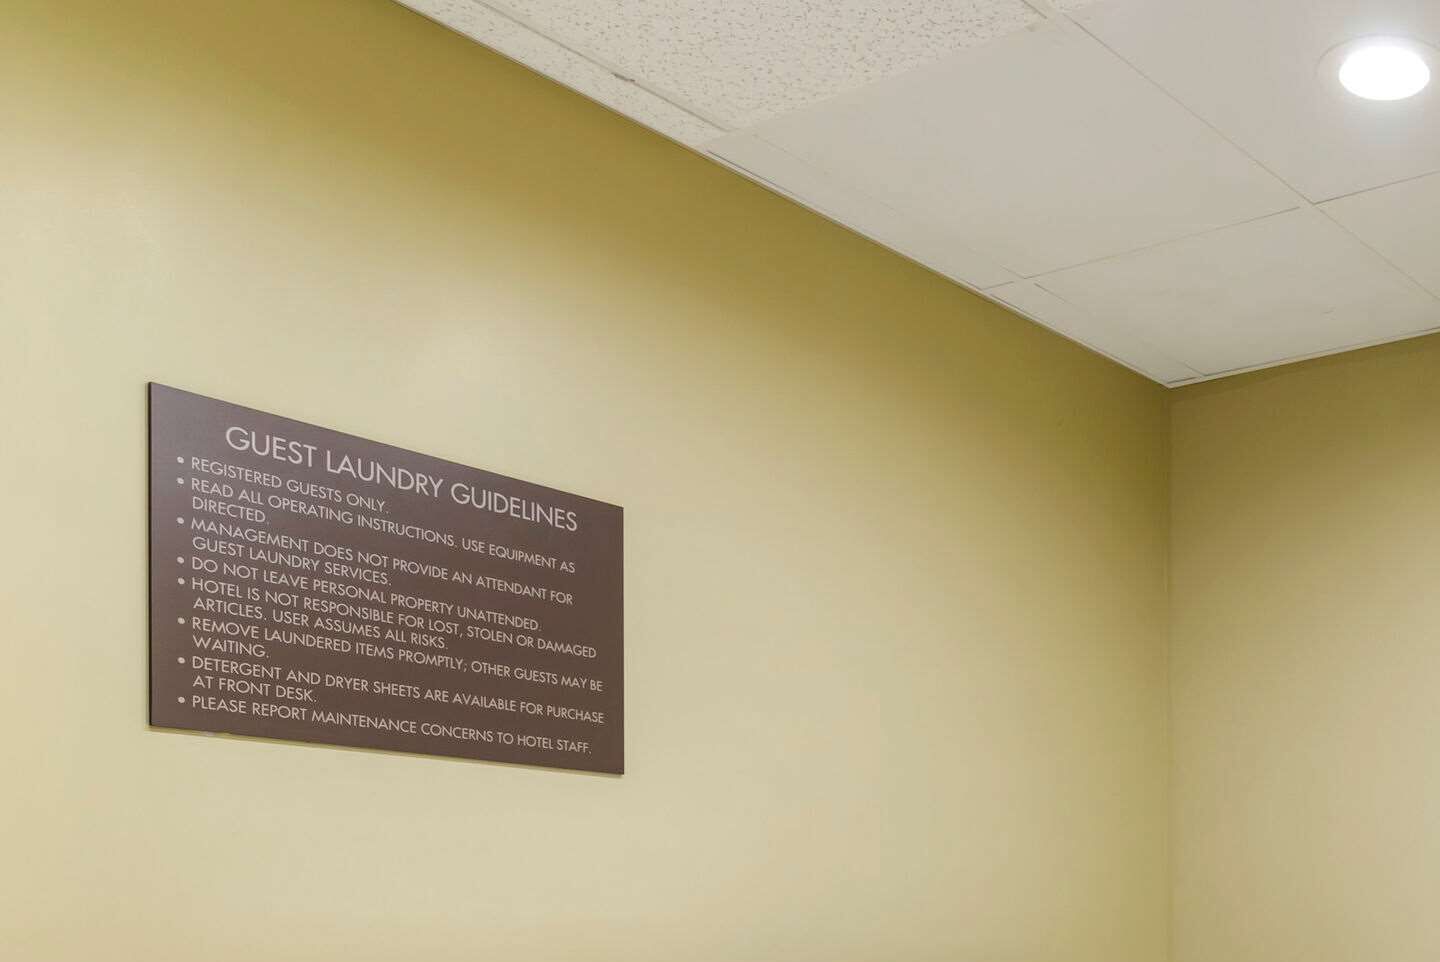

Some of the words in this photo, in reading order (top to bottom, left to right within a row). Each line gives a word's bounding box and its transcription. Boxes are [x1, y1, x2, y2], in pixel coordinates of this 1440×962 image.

[192, 457, 282, 488] REGISTERED
[286, 479, 342, 502] GUESTS
[346, 493, 389, 514] ONLY.
[192, 496, 268, 524] DIRECTED.
[226, 426, 317, 467] GUEST
[326, 450, 443, 498] LAUNDRY
[451, 483, 577, 532] GUIDELINES
[192, 477, 234, 497] READ
[238, 489, 264, 505] ALL
[268, 495, 353, 524] OPERATING
[358, 514, 457, 548] INSTRUCTIONS.
[462, 538, 485, 554] USE
[489, 544, 557, 569] EQUIPMENT
[559, 561, 575, 573] AS
[191, 518, 309, 552] MANAGEMENT
[314, 541, 353, 561] DOES
[358, 551, 389, 568] NOT
[393, 558, 448, 580] PROVIDE
[452, 571, 472, 584] AN
[475, 576, 547, 600] ATTENDANT
[550, 590, 573, 605] FOR
[192, 536, 245, 557] GUEST
[250, 547, 320, 571] LAUNDRY
[324, 562, 391, 586] SERVICES.
[192, 556, 218, 573] DO
[224, 562, 258, 580] NOT
[263, 570, 308, 590] LEAVE
[313, 579, 387, 604] PERSONAL
[391, 593, 454, 615] PROPERTY
[457, 606, 541, 631] UNATTENDED.
[192, 577, 243, 598] HOTEL
[247, 587, 260, 601] IS
[265, 590, 299, 607] NOT
[304, 597, 394, 624] RESPONSIBLE
[398, 613, 424, 629] FOR
[429, 619, 463, 638] LOST,
[466, 626, 513, 644] STOLEN
[516, 634, 534, 648] OR
[537, 638, 597, 658] DAMAGED
[193, 597, 266, 621] ARTICLES.
[273, 609, 309, 627] USER
[314, 617, 381, 638] ASSUMES
[385, 629, 406, 643] ALL
[411, 632, 448, 650] RISKS.
[192, 635, 269, 658] WAITING.
[192, 616, 259, 639] REMOVE
[264, 628, 351, 653] LAUNDERED
[356, 642, 394, 659] ITEMS
[398, 649, 467, 672] PROMPTLY;
[471, 660, 511, 678] OTHER
[514, 667, 558, 685] GUESTS
[561, 676, 587, 688] MAY
[590, 679, 603, 692] BE
[192, 675, 214, 689] AT
[219, 678, 271, 696] FRONT
[276, 685, 316, 702] DESK.
[192, 656, 282, 679] DETERGENT
[286, 669, 321, 685] AND
[325, 674, 369, 692] DRYER
[373, 681, 420, 699] SHEETS
[424, 689, 449, 703] ARE
[452, 693, 516, 712] AVAILABLE
[520, 701, 543, 715] FOR
[547, 705, 604, 724] PURCHASE
[192, 695, 246, 714] PLEASE
[252, 702, 307, 720] REPORT
[311, 710, 416, 734] MAINTENANCE
[420, 723, 493, 743] CONCERNS
[497, 731, 514, 745] TO
[517, 734, 554, 749] HOTEL
[557, 739, 591, 754] STAFF.
